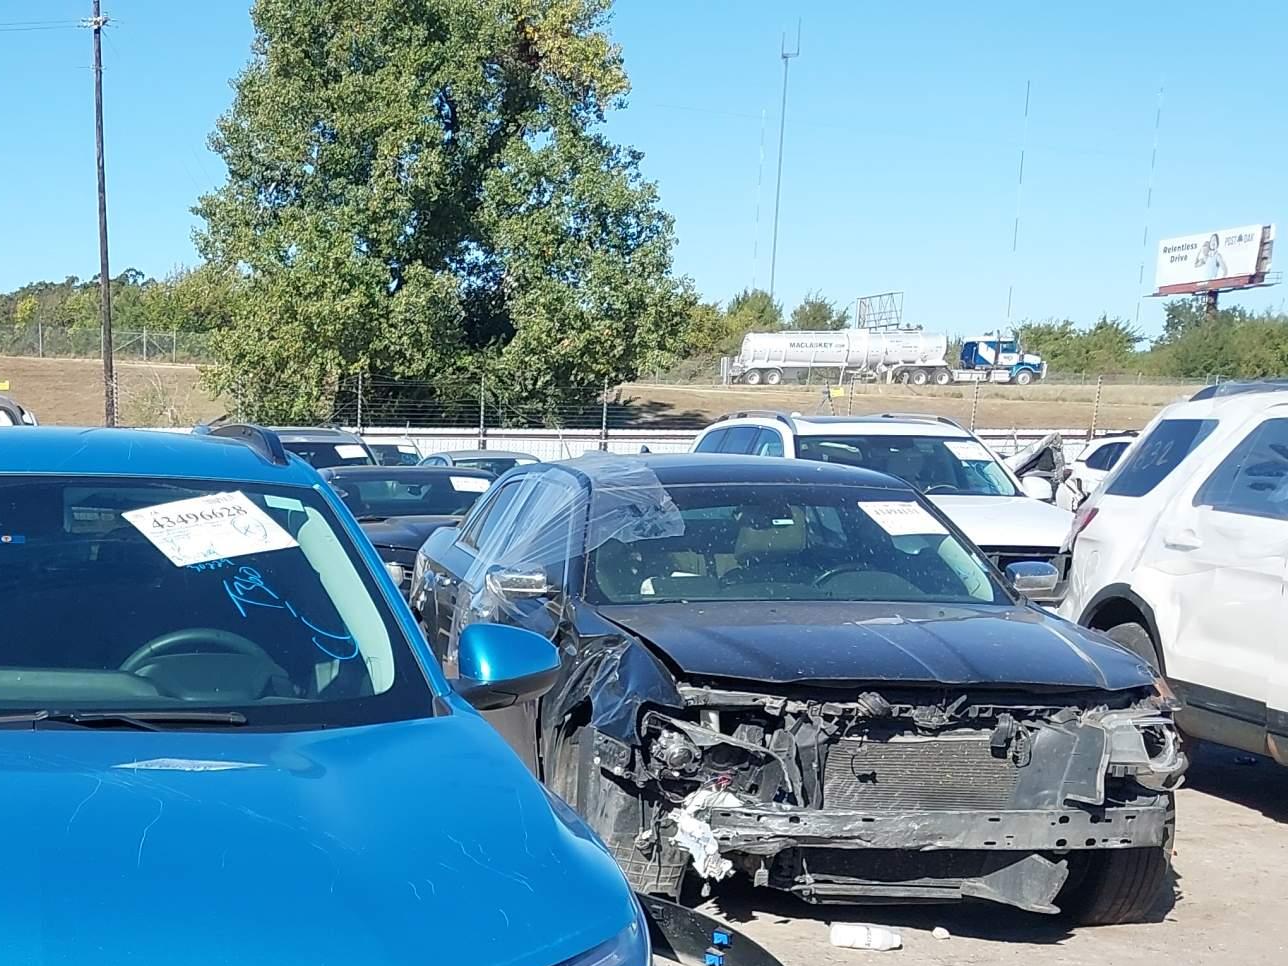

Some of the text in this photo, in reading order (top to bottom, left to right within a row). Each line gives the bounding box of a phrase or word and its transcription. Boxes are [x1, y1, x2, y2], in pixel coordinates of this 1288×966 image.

[1162, 242, 1198, 254] Relentless
[1170, 254, 1188, 264] Drive
[151, 504, 248, 530] 43496628
